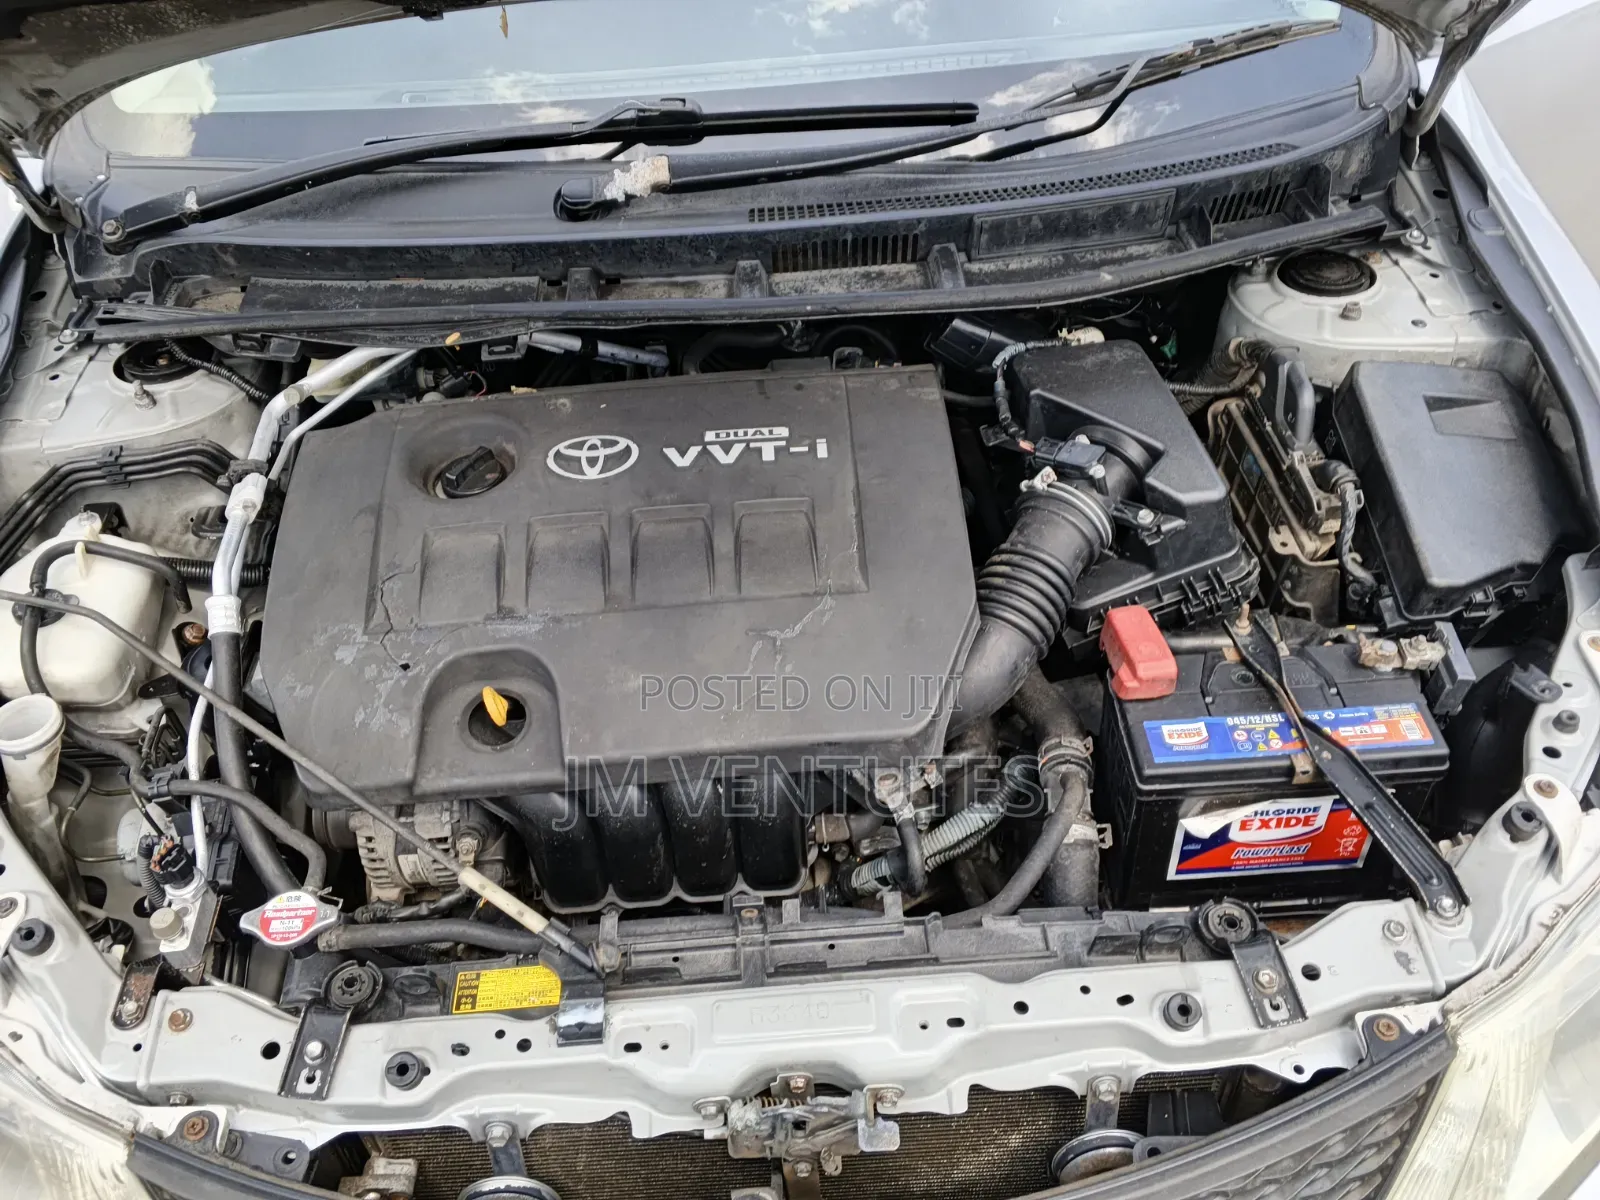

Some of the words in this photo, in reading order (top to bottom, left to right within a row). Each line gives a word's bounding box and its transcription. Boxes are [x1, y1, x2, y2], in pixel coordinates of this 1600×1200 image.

[715, 428, 782, 439] DUAL
[662, 438, 829, 467] VVT-i
[1167, 731, 1204, 740] EXIDE
[1238, 814, 1319, 832] EXIDE
[458, 988, 478, 996] ATTENTION
